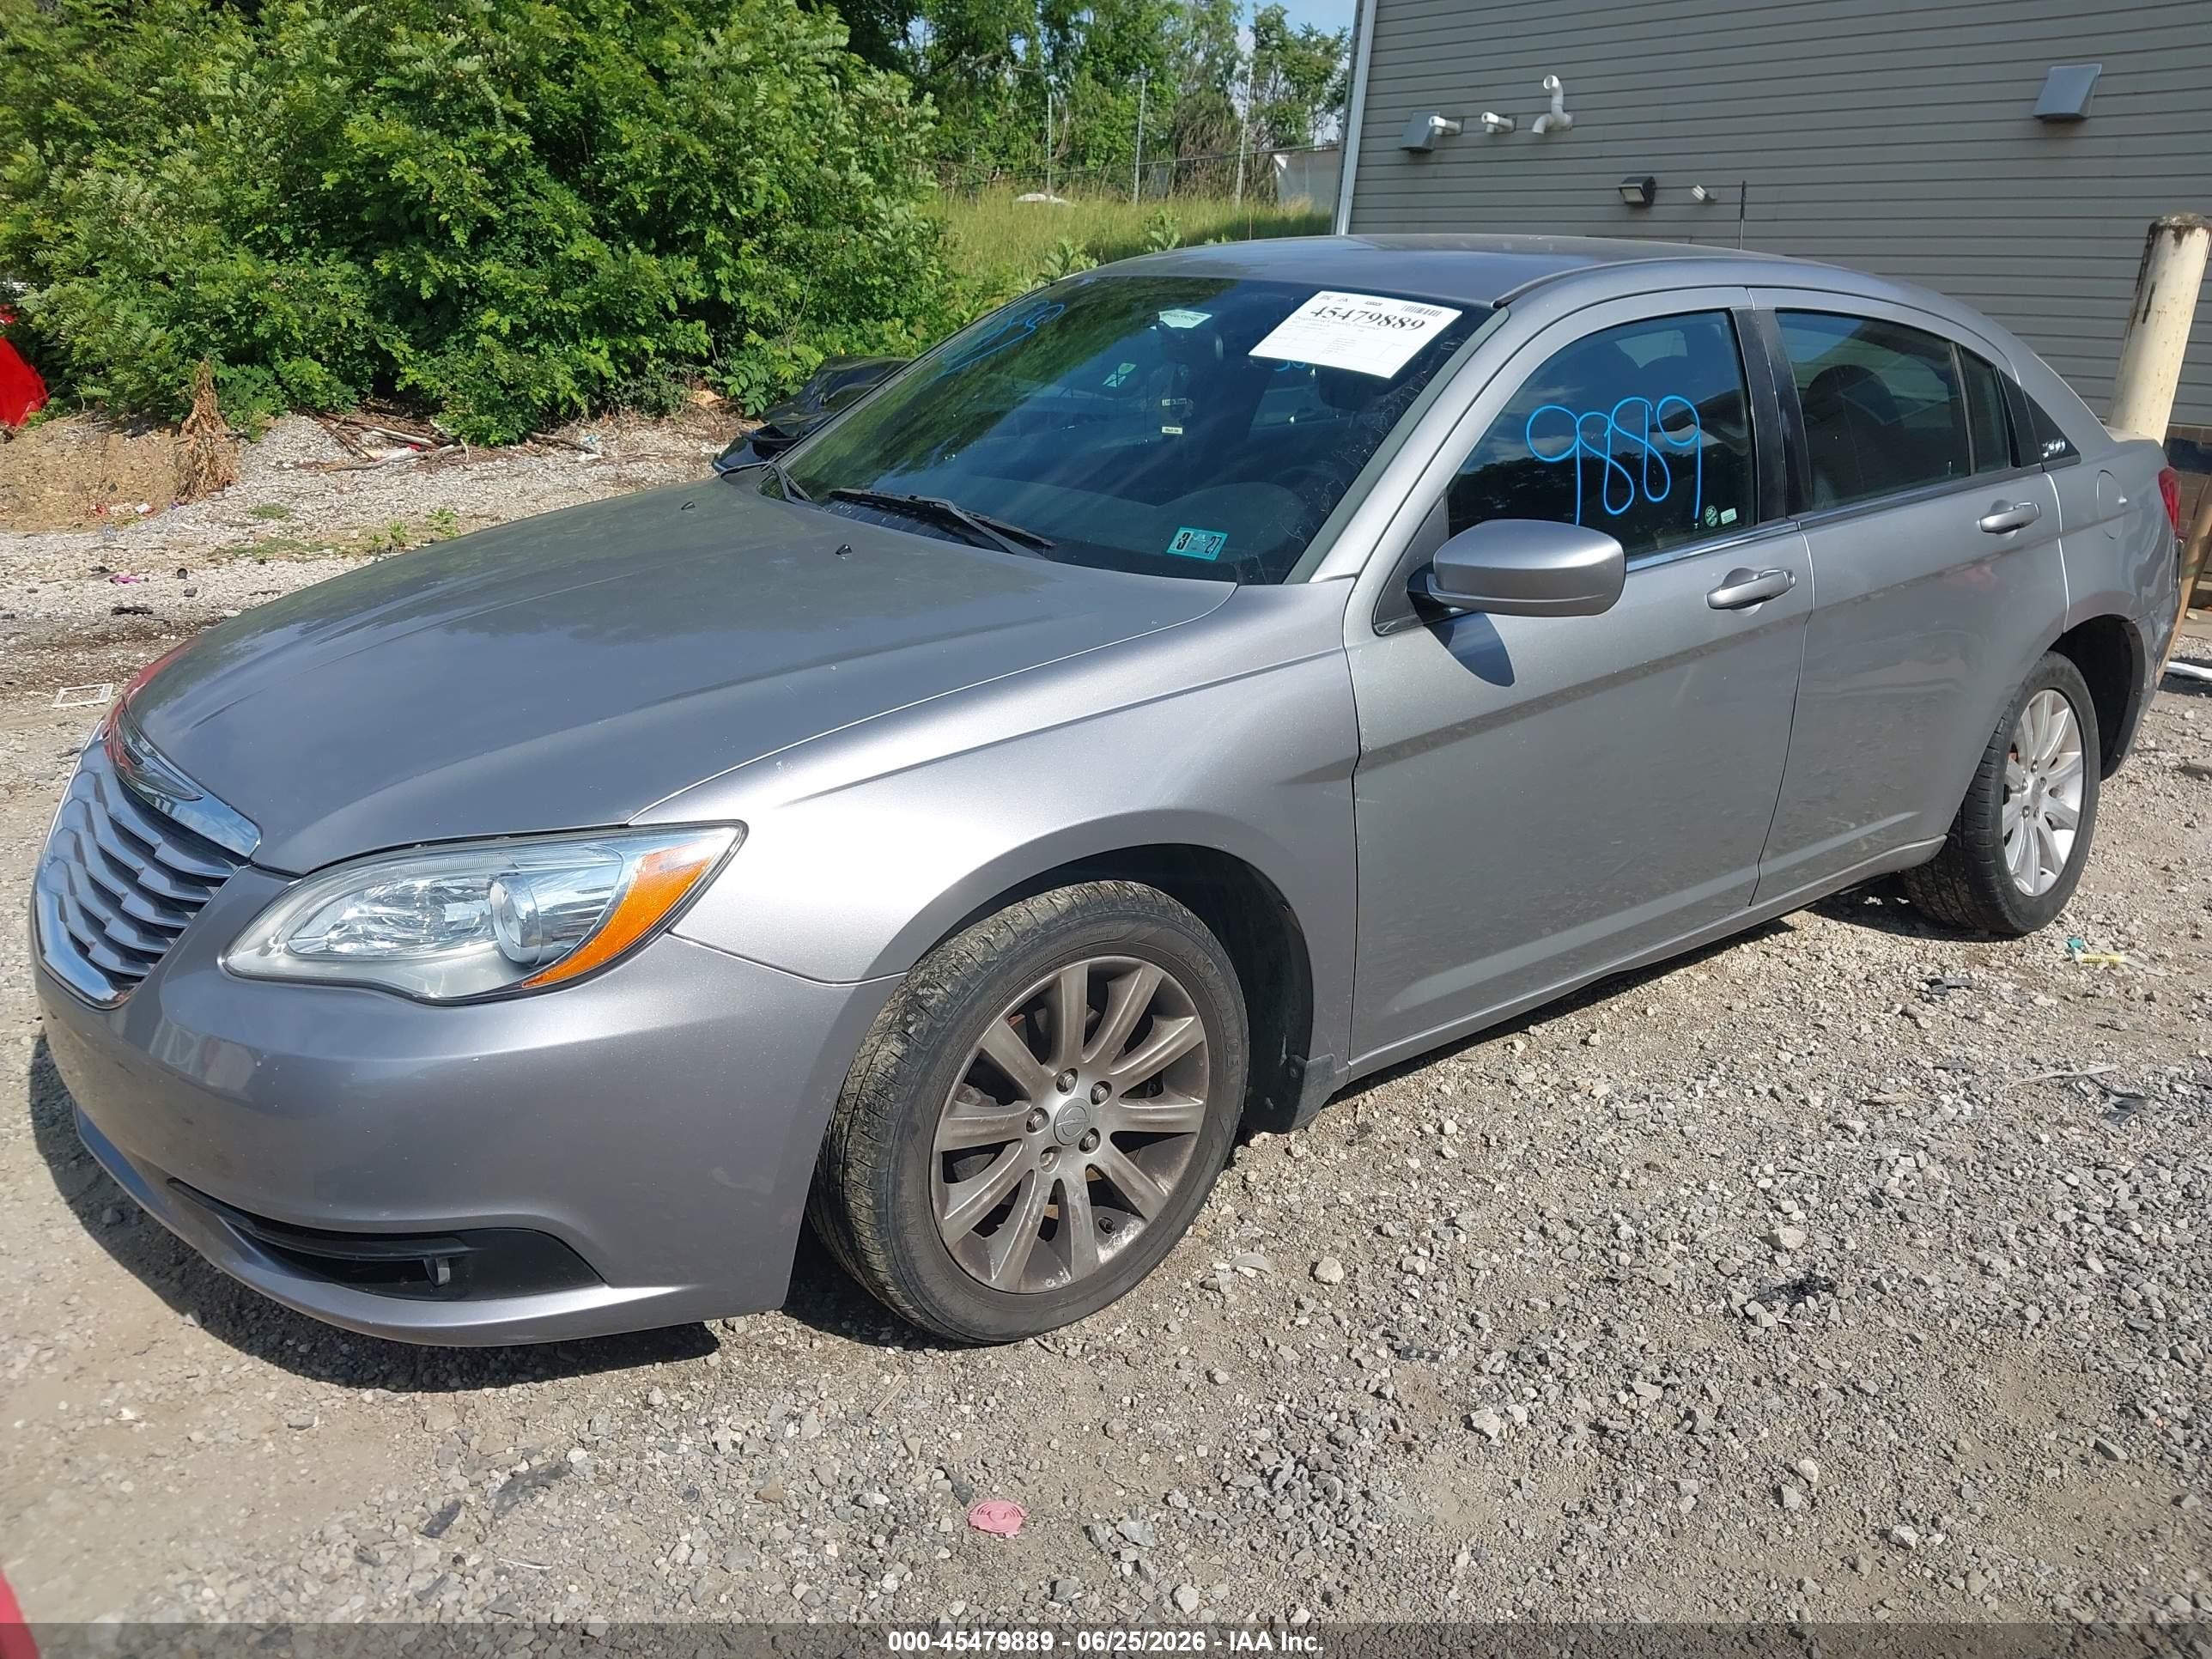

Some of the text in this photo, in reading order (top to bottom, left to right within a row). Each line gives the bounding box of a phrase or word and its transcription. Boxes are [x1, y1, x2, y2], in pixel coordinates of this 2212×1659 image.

[1310, 305, 1426, 331] 45479889
[1526, 395, 1701, 526] 9889
[1204, 535, 1223, 556] 27
